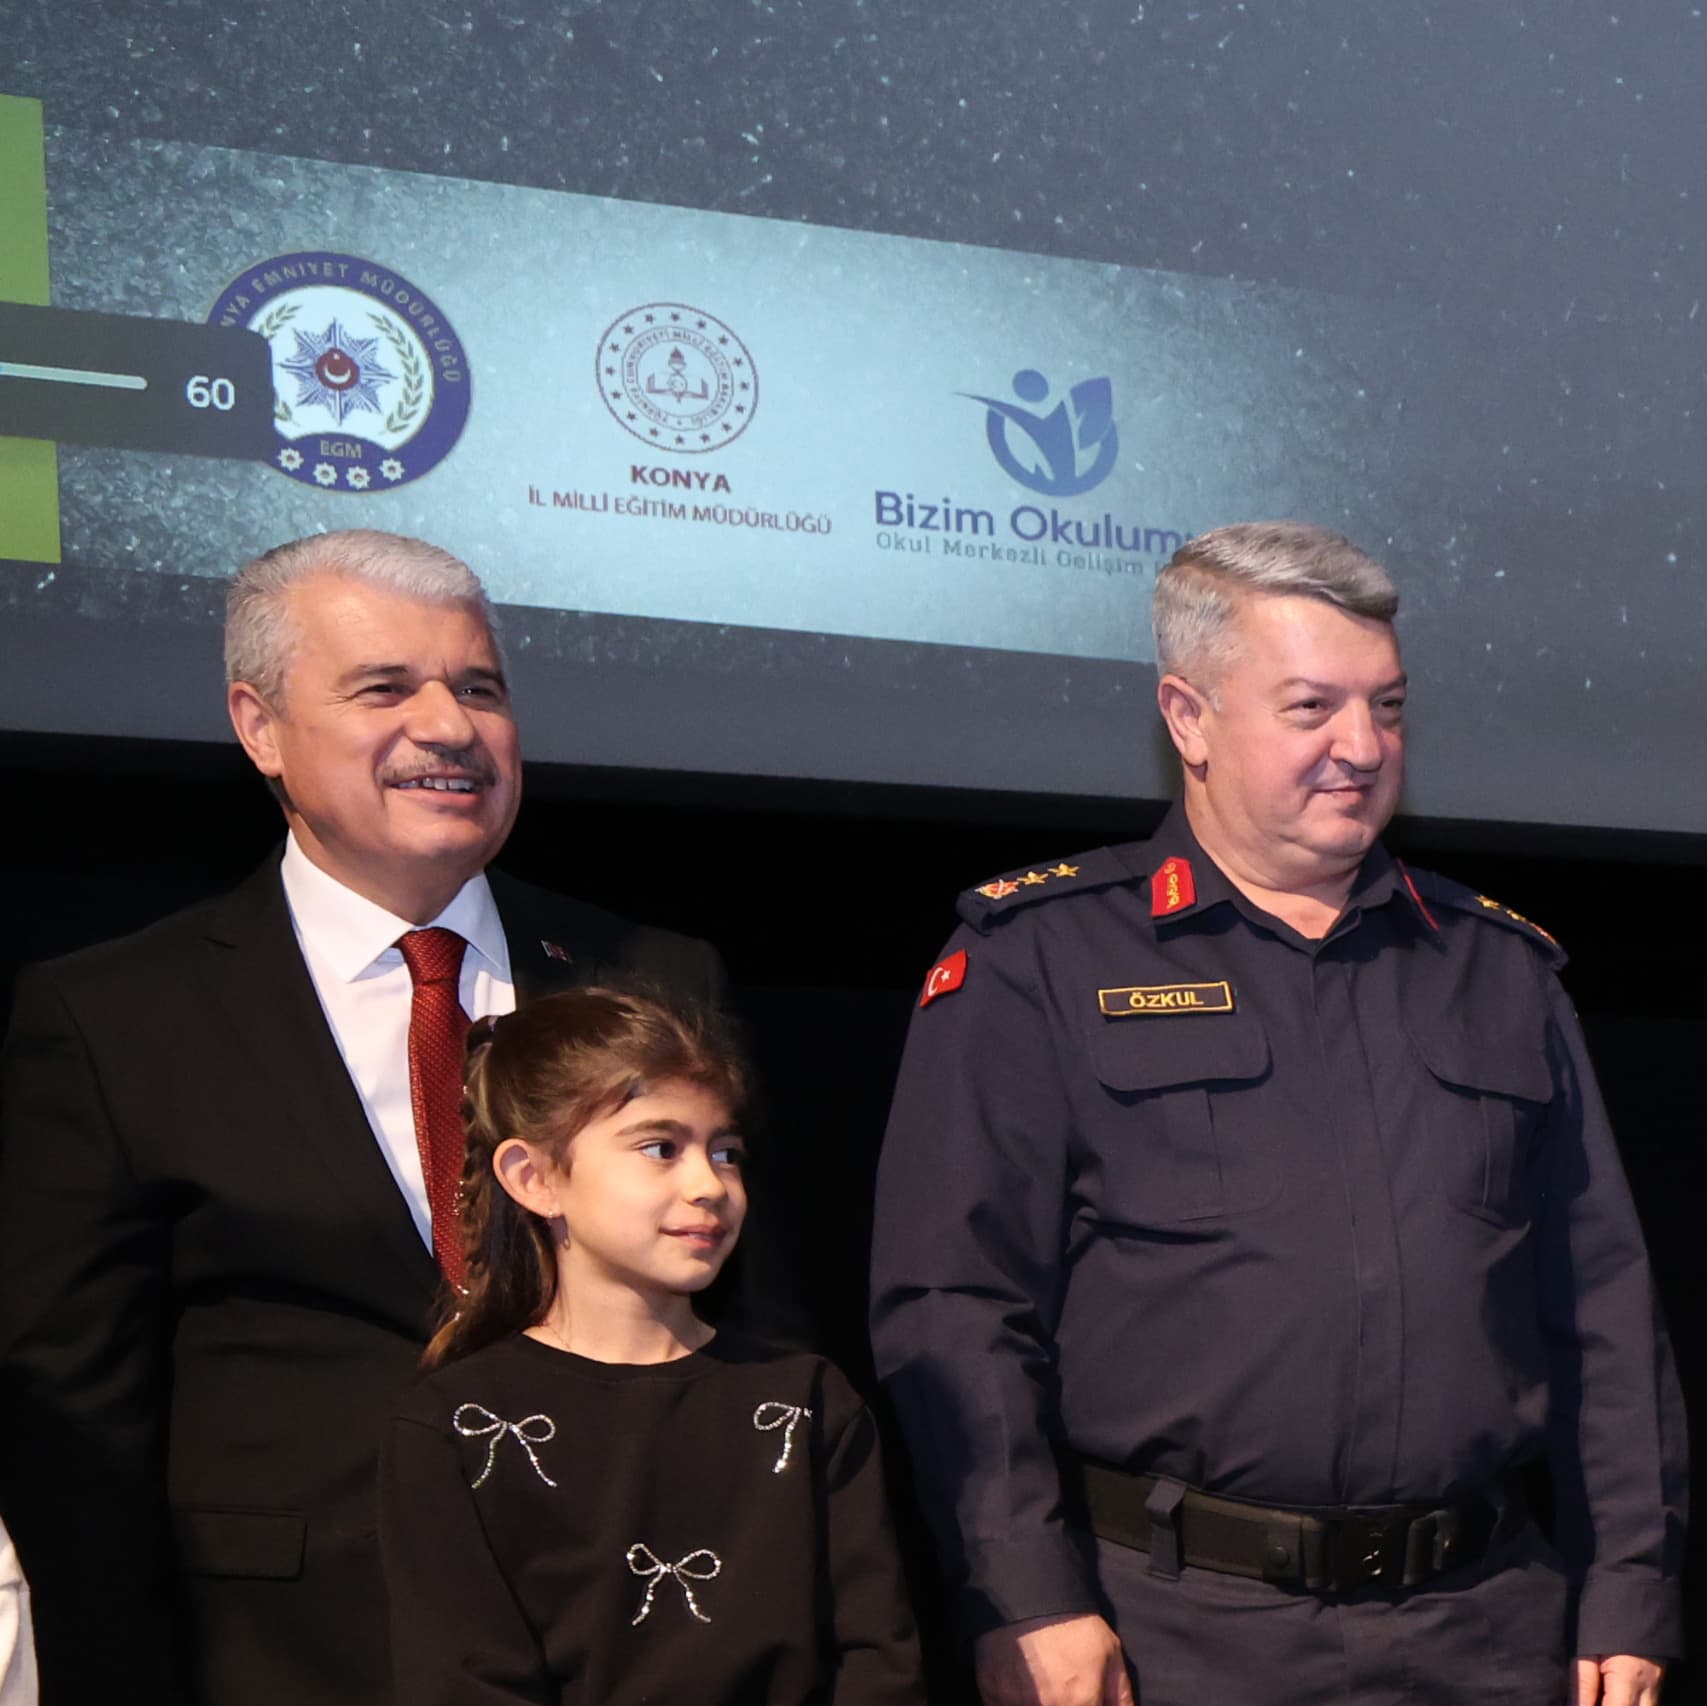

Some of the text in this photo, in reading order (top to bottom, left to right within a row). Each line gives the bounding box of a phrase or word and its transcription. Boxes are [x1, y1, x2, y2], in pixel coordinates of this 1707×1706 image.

[186, 376, 235, 411] 60
[320, 440, 362, 458] EGM
[630, 464, 731, 494] KONYA
[528, 485, 832, 535] İL MİLLİ EĞİTİM MÜDÜRLÜĞÜ
[875, 490, 1194, 553] Bizim Okulum
[876, 532, 931, 553] Okul
[943, 538, 1048, 567] Merkezli
[1129, 991, 1205, 1008] ÖZKUL
